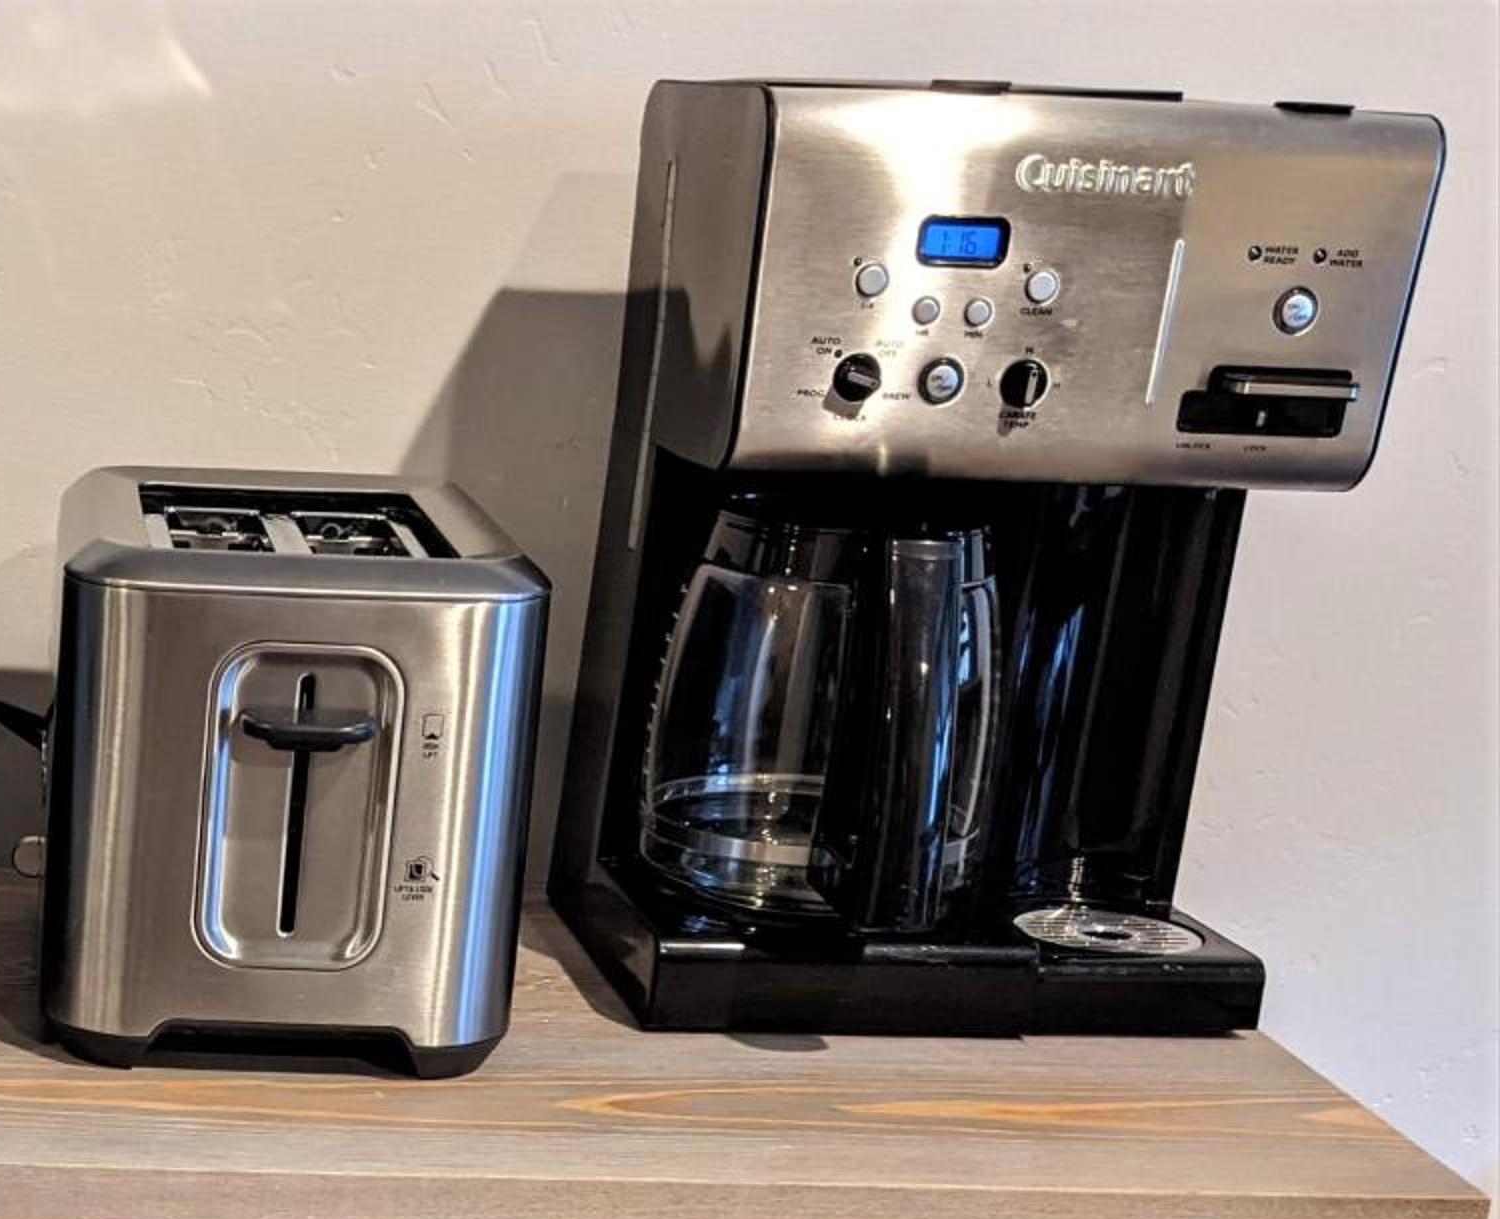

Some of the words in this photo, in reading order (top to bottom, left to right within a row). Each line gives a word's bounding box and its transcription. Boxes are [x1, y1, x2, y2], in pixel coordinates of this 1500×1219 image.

[1015, 153, 1196, 197] Cuisinart
[941, 230, 978, 255] 1:16
[1265, 246, 1299, 254] WATER
[1330, 259, 1363, 267] WATER
[1020, 307, 1053, 315] CLEAN
[812, 336, 841, 345] AUTO
